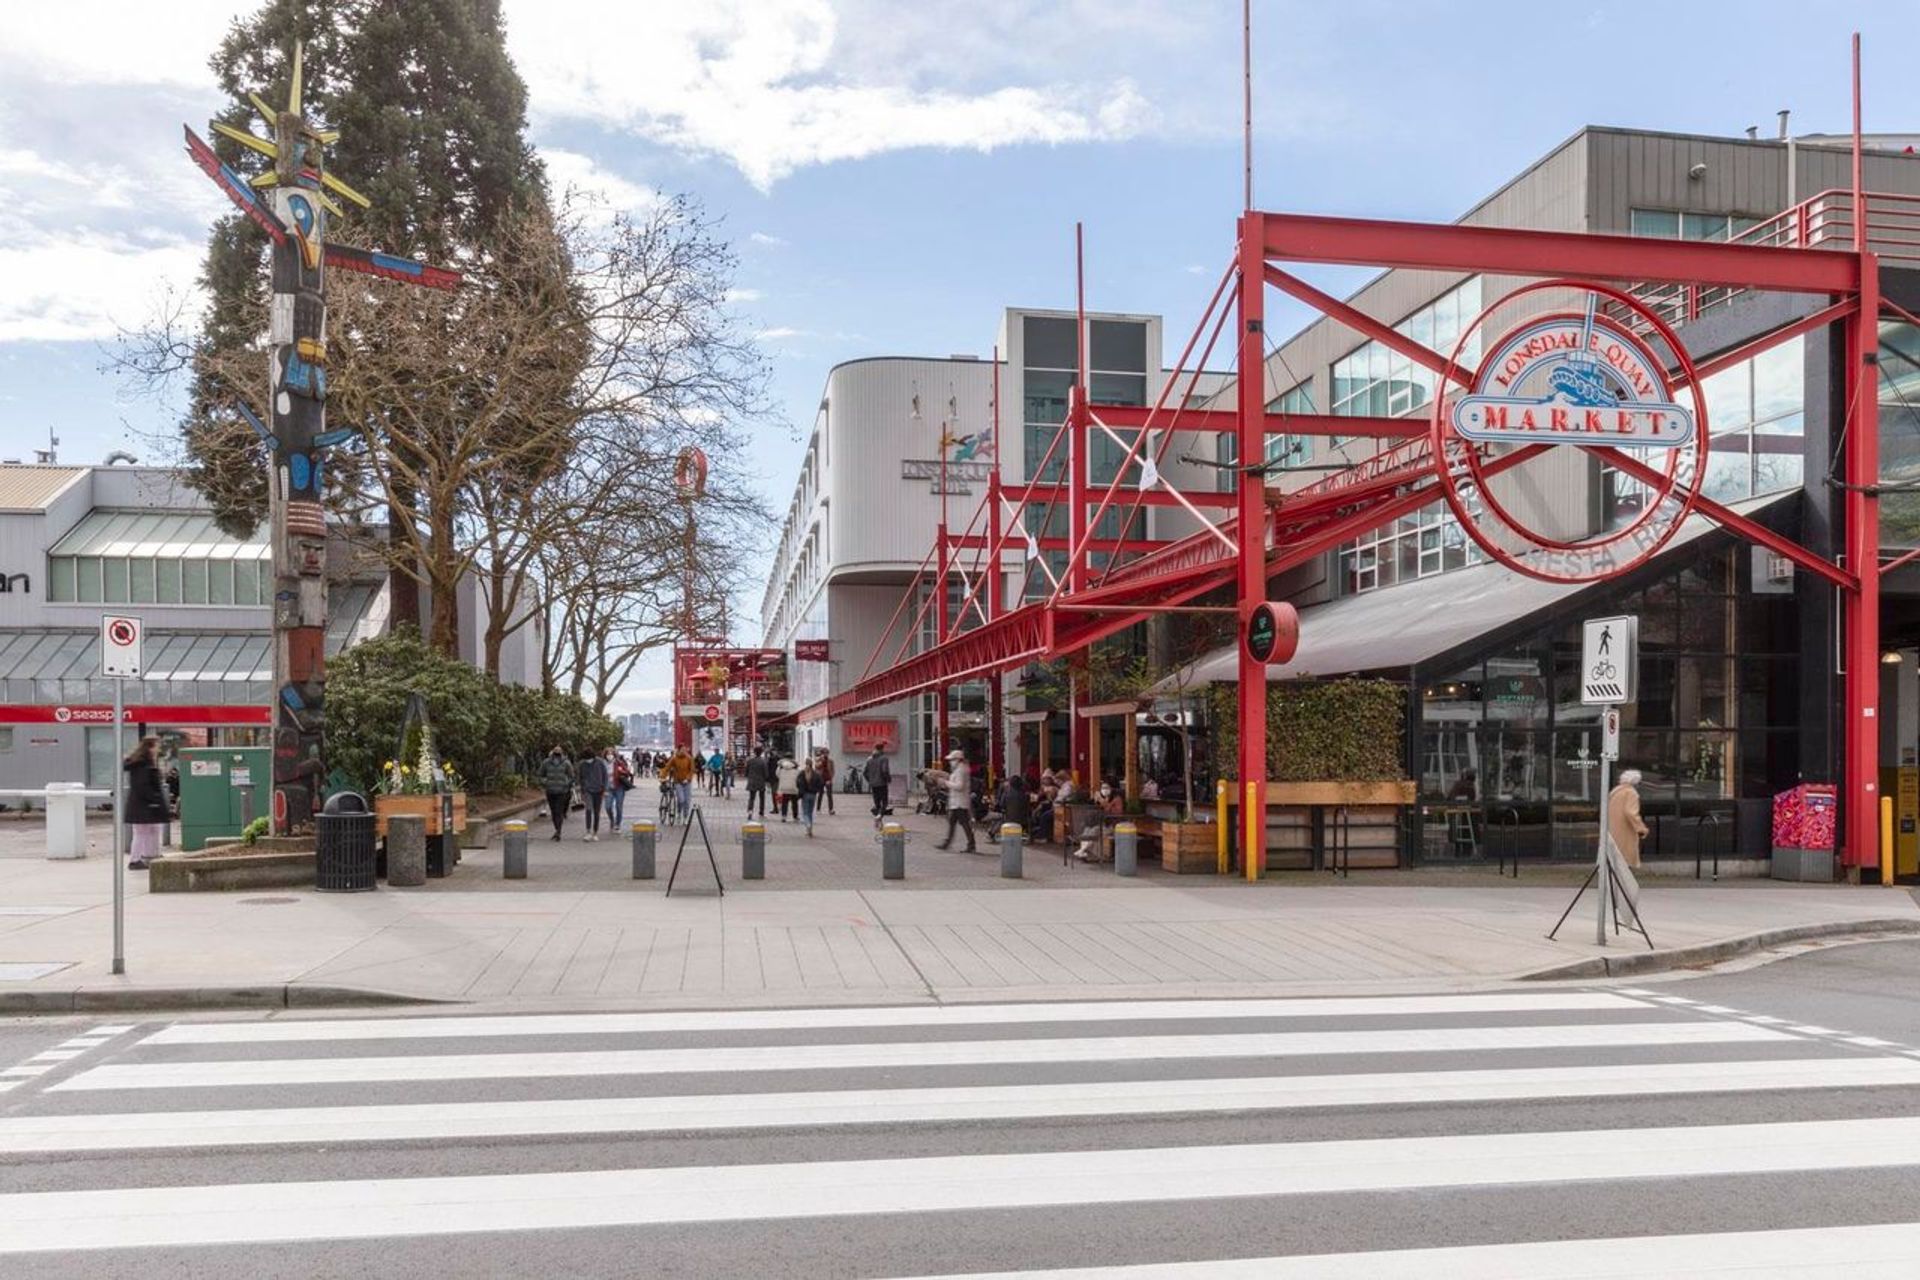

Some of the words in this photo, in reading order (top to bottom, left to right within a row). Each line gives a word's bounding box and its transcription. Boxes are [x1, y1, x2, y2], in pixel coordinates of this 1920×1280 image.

[1495, 332, 1599, 388] LONSDALE
[1605, 344, 1655, 396] QUAY
[1484, 406, 1667, 434] MARKET
[71, 709, 132, 721] seaspn
